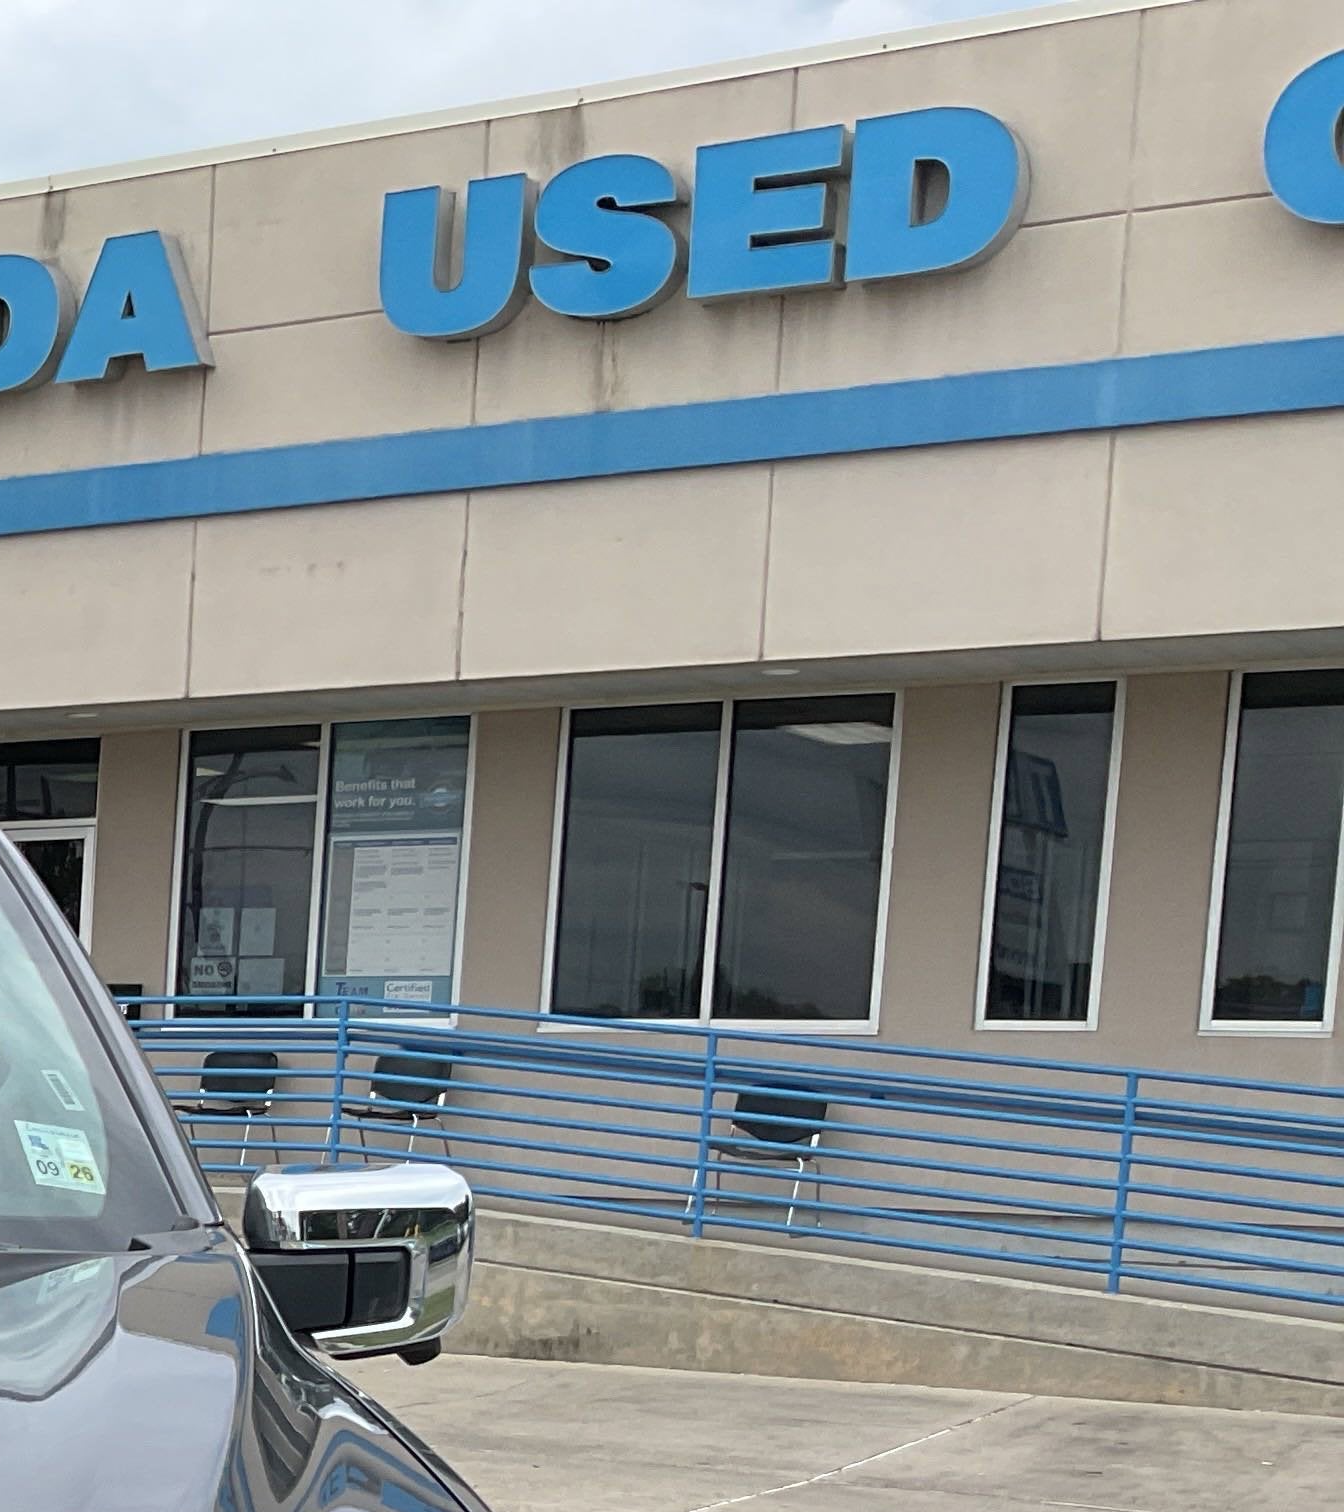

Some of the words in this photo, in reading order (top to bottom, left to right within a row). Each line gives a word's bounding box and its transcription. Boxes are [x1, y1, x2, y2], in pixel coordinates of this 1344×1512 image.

[379, 106, 1028, 341] USED
[335, 780, 388, 792] Benefits
[391, 778, 416, 789] that
[335, 798, 365, 808] work
[369, 796, 386, 808] for
[390, 796, 416, 808] you.
[194, 964, 214, 976] NO
[386, 983, 430, 993] Certified
[36, 1159, 59, 1176] 09
[70, 1164, 94, 1181] 26
